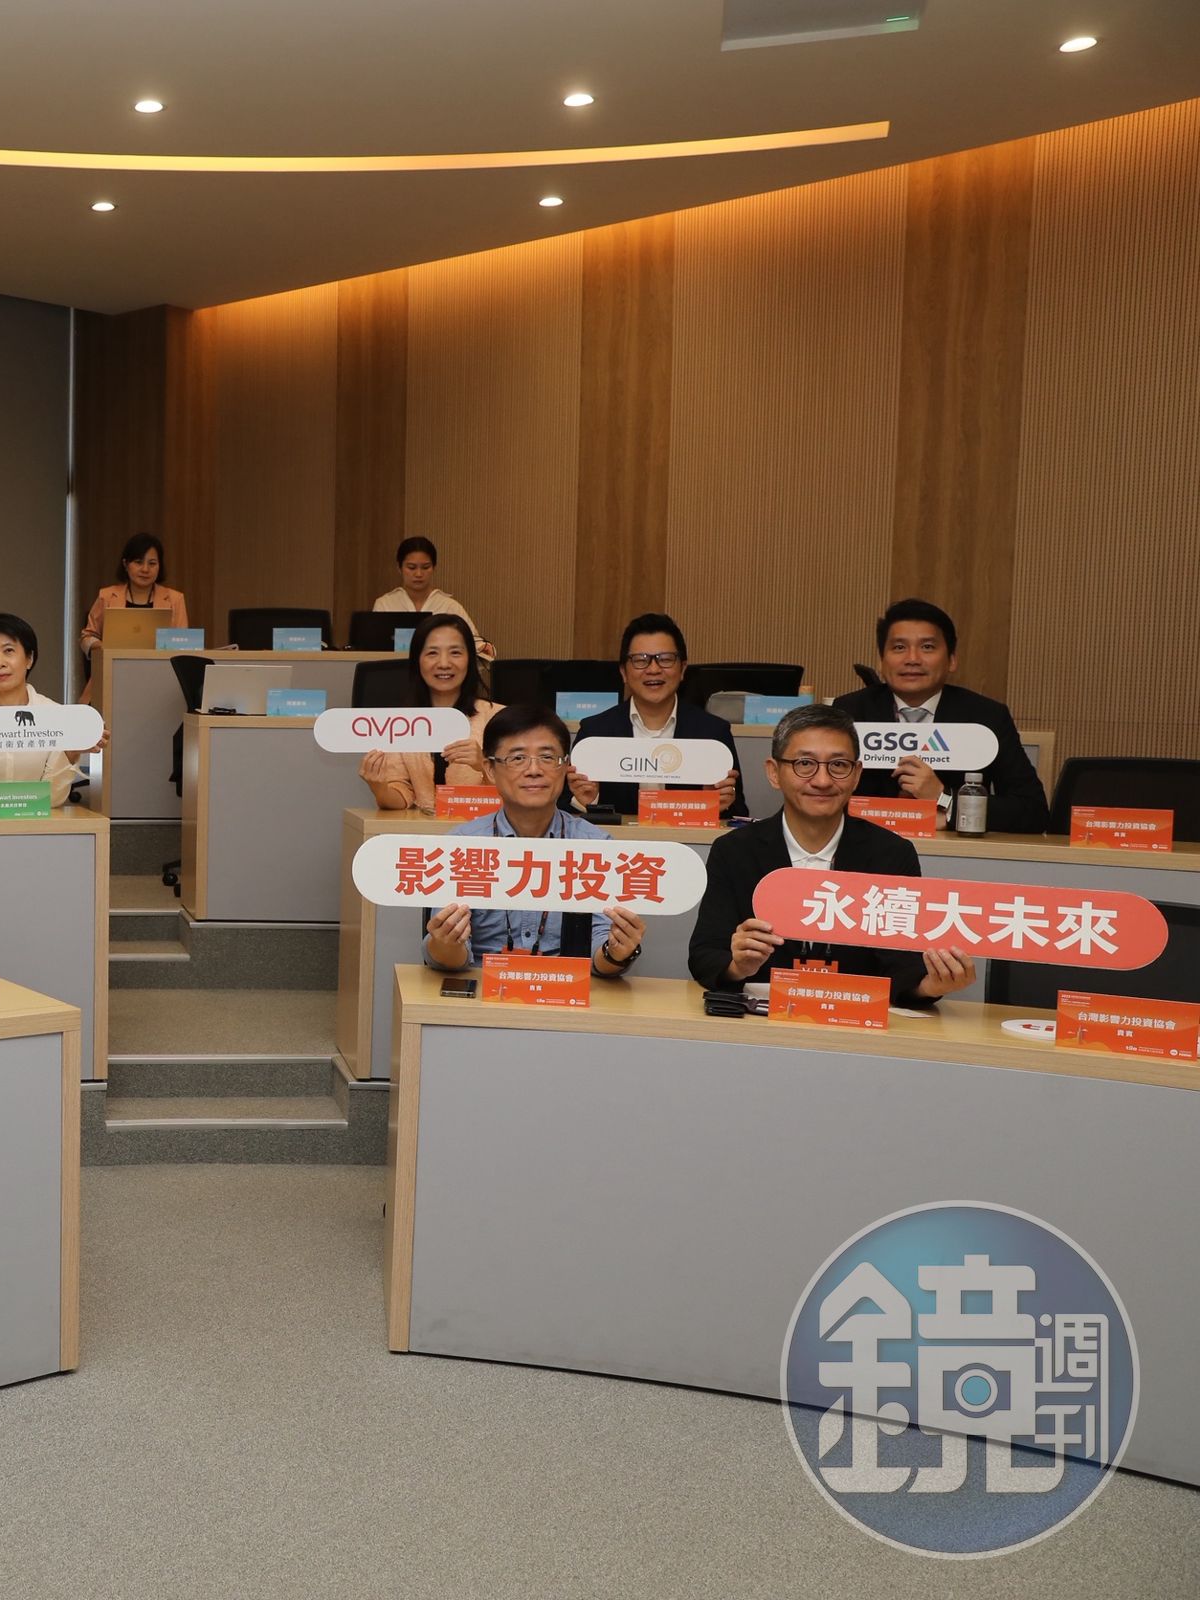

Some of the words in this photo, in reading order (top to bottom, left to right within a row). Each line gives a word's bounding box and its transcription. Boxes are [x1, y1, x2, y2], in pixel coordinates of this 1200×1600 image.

[23, 729, 64, 738] Investors
[351, 716, 432, 744] avpn
[863, 732, 918, 751] GSG
[620, 757, 658, 772] GIIN
[864, 754, 896, 763] Driving
[394, 847, 667, 903] 影響力投資
[800, 880, 1119, 955] 永續大未來
[788, 987, 871, 1003] 台灣影響力投資協會
[1078, 1011, 1177, 1030] 台灣影響力投資協會
